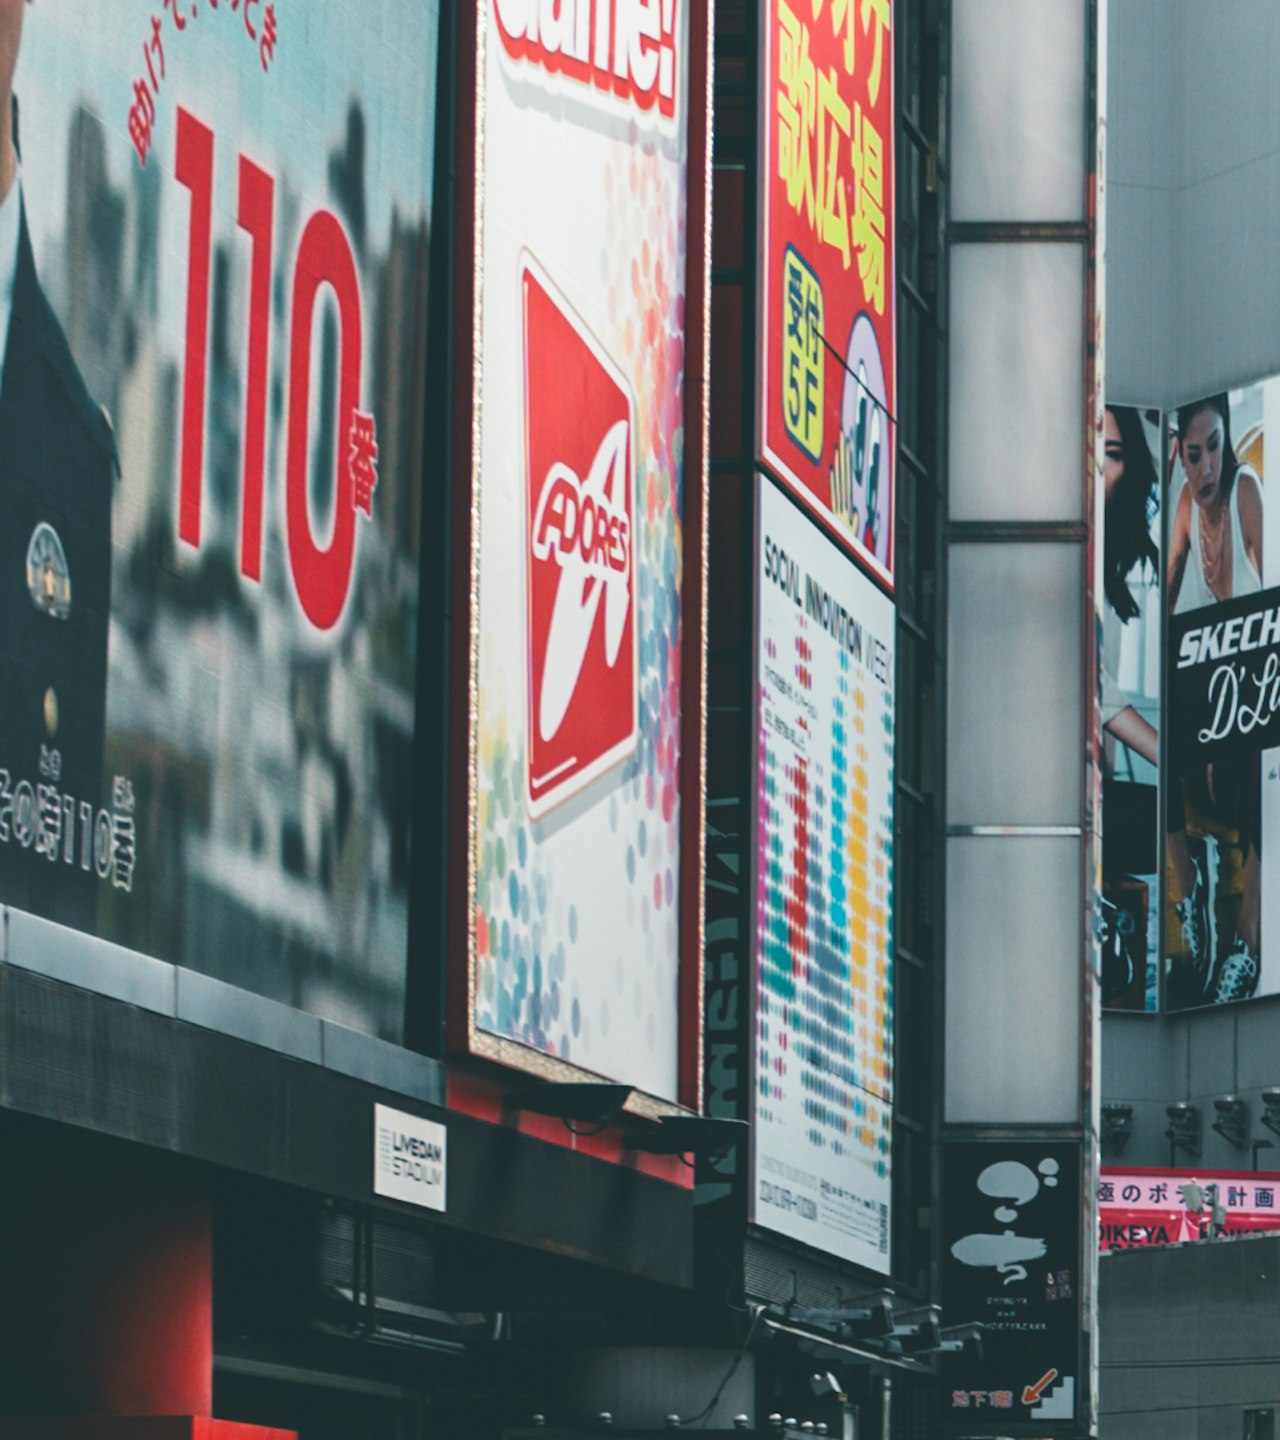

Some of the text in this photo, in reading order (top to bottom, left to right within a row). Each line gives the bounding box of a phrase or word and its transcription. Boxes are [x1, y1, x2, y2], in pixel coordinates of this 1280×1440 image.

[787, 266, 821, 353] 受付
[787, 354, 820, 444] 5F
[533, 461, 630, 573] ADORES
[765, 534, 802, 608] SOCIAL
